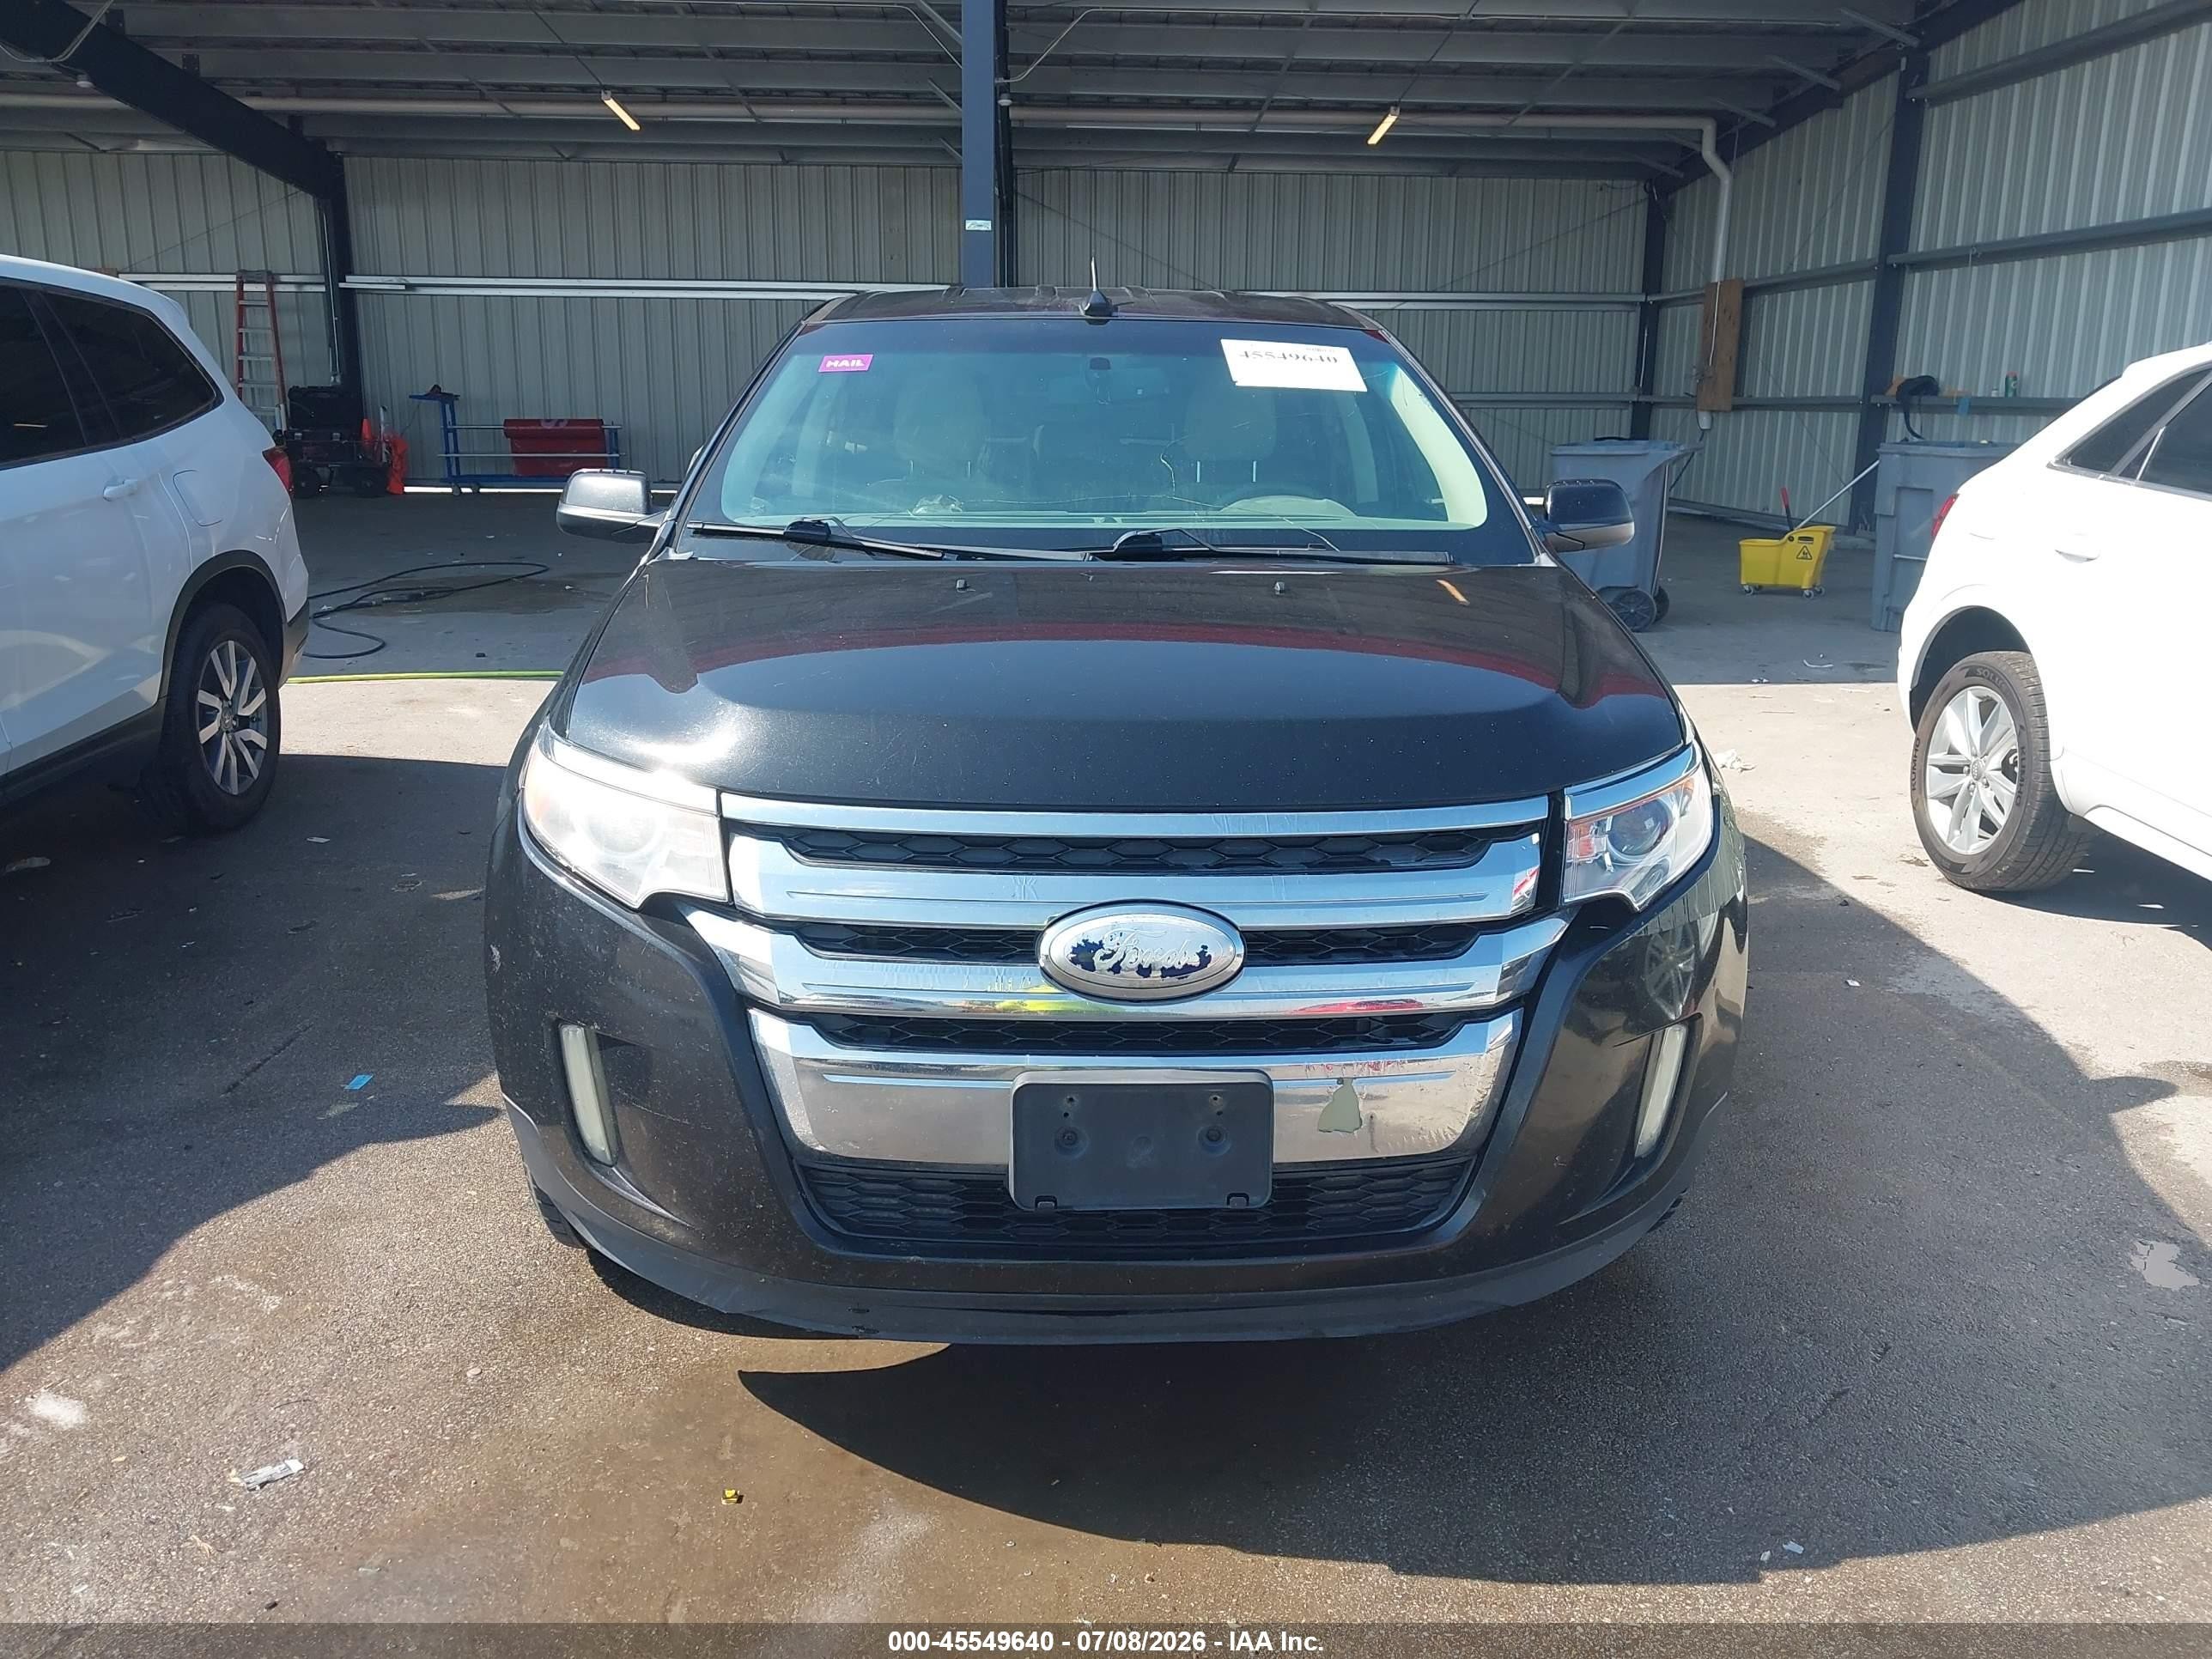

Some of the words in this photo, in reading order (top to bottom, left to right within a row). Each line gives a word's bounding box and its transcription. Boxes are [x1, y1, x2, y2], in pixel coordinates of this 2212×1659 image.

[825, 359, 866, 368] HAIL
[2015, 746, 2026, 806] KUMHO
[1093, 927, 1201, 970] Ford
